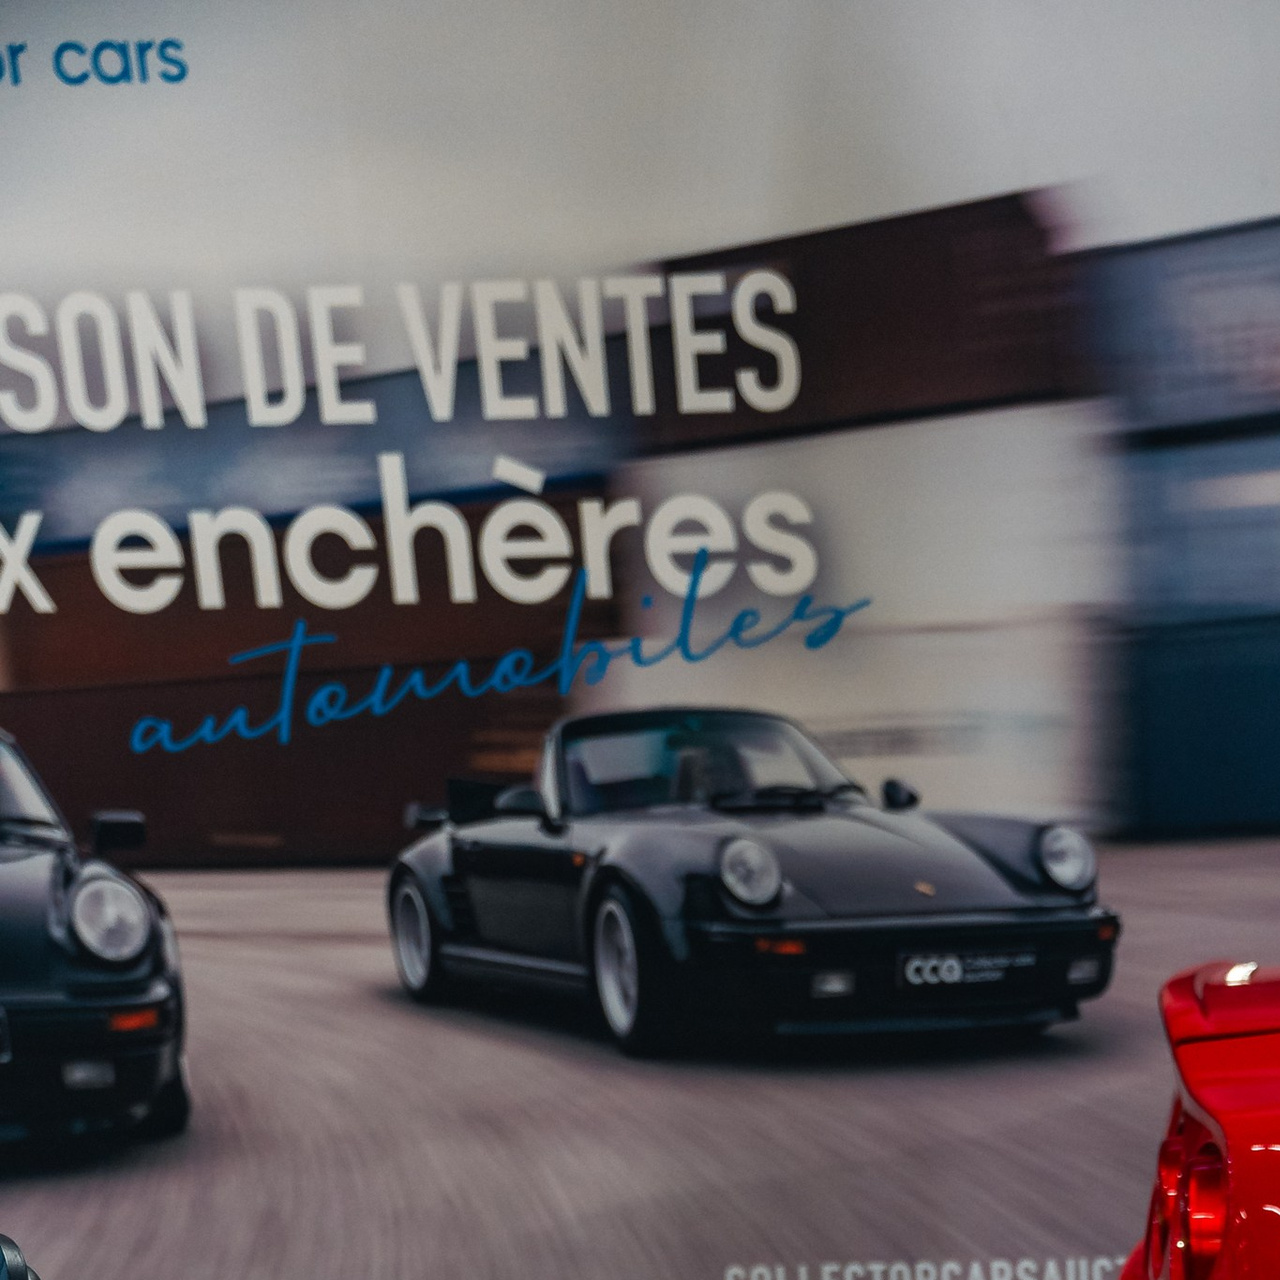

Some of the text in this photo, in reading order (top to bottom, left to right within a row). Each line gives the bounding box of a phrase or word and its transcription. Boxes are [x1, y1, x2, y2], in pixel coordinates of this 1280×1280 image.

[53, 38, 190, 86] cars
[233, 284, 379, 428] DE
[397, 269, 802, 423] VENTES
[90, 453, 819, 614] enchères
[130, 548, 872, 754] automobiles
